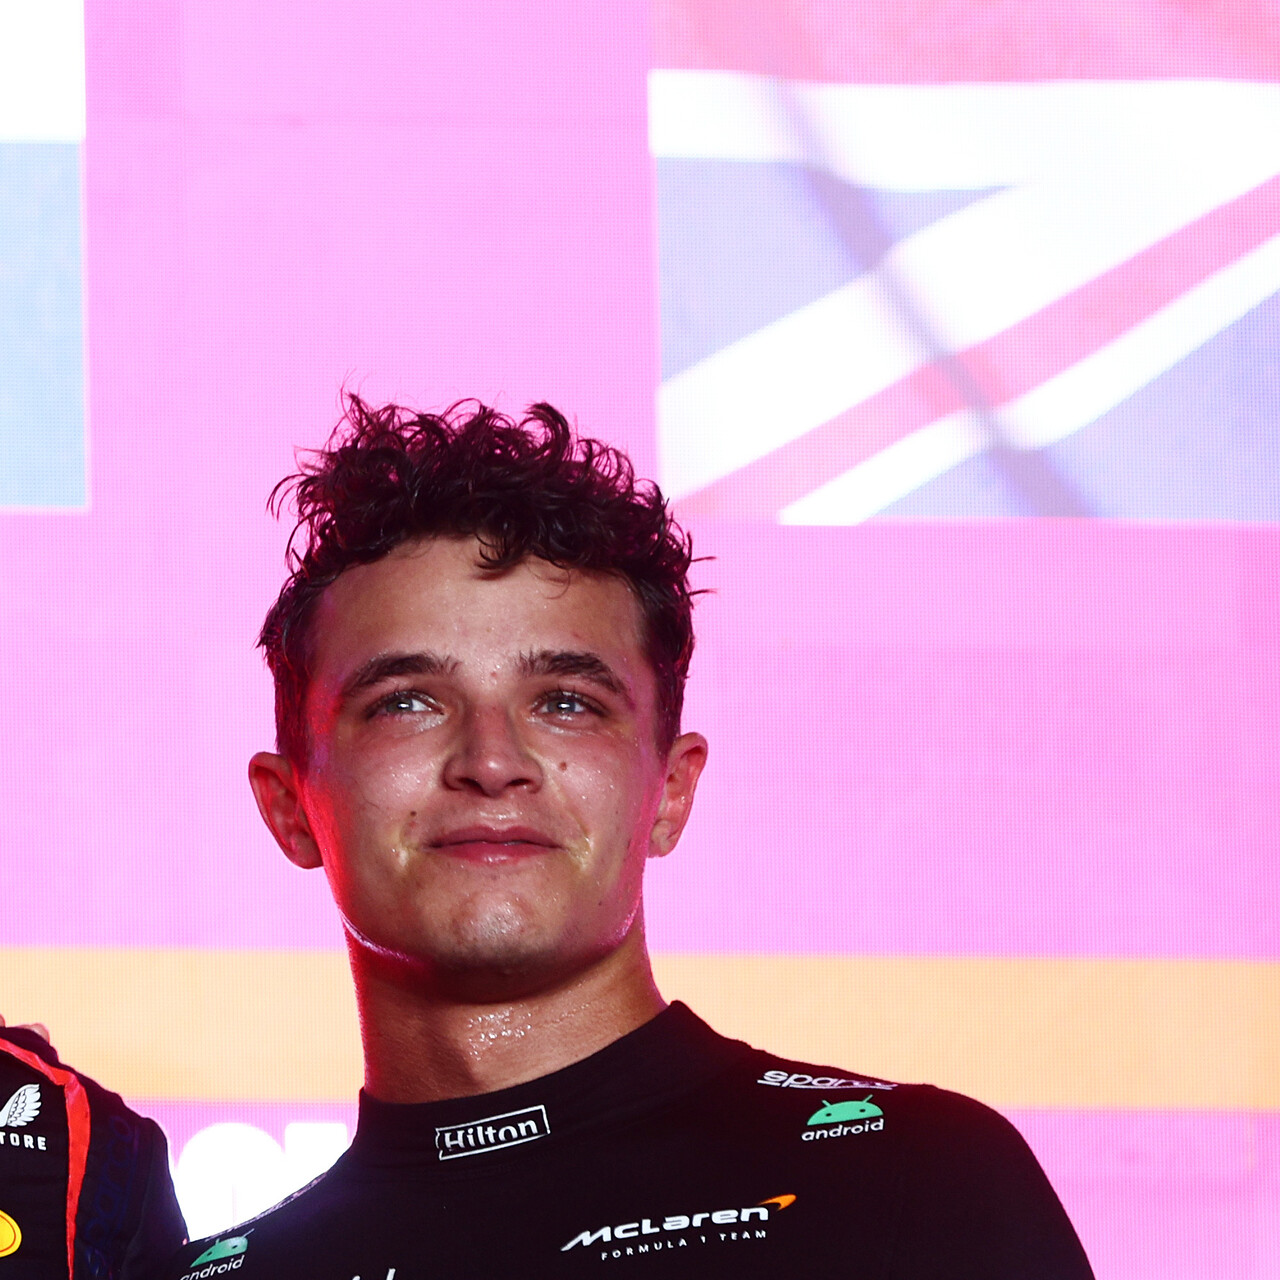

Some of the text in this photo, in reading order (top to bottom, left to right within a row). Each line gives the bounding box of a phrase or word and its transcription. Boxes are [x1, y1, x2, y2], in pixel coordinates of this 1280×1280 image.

[443, 1115, 539, 1153] Hilton
[801, 1118, 884, 1141] android
[561, 1206, 770, 1251] McLaren
[601, 1240, 686, 1261] FORMULA
[720, 1230, 768, 1241] TEAM
